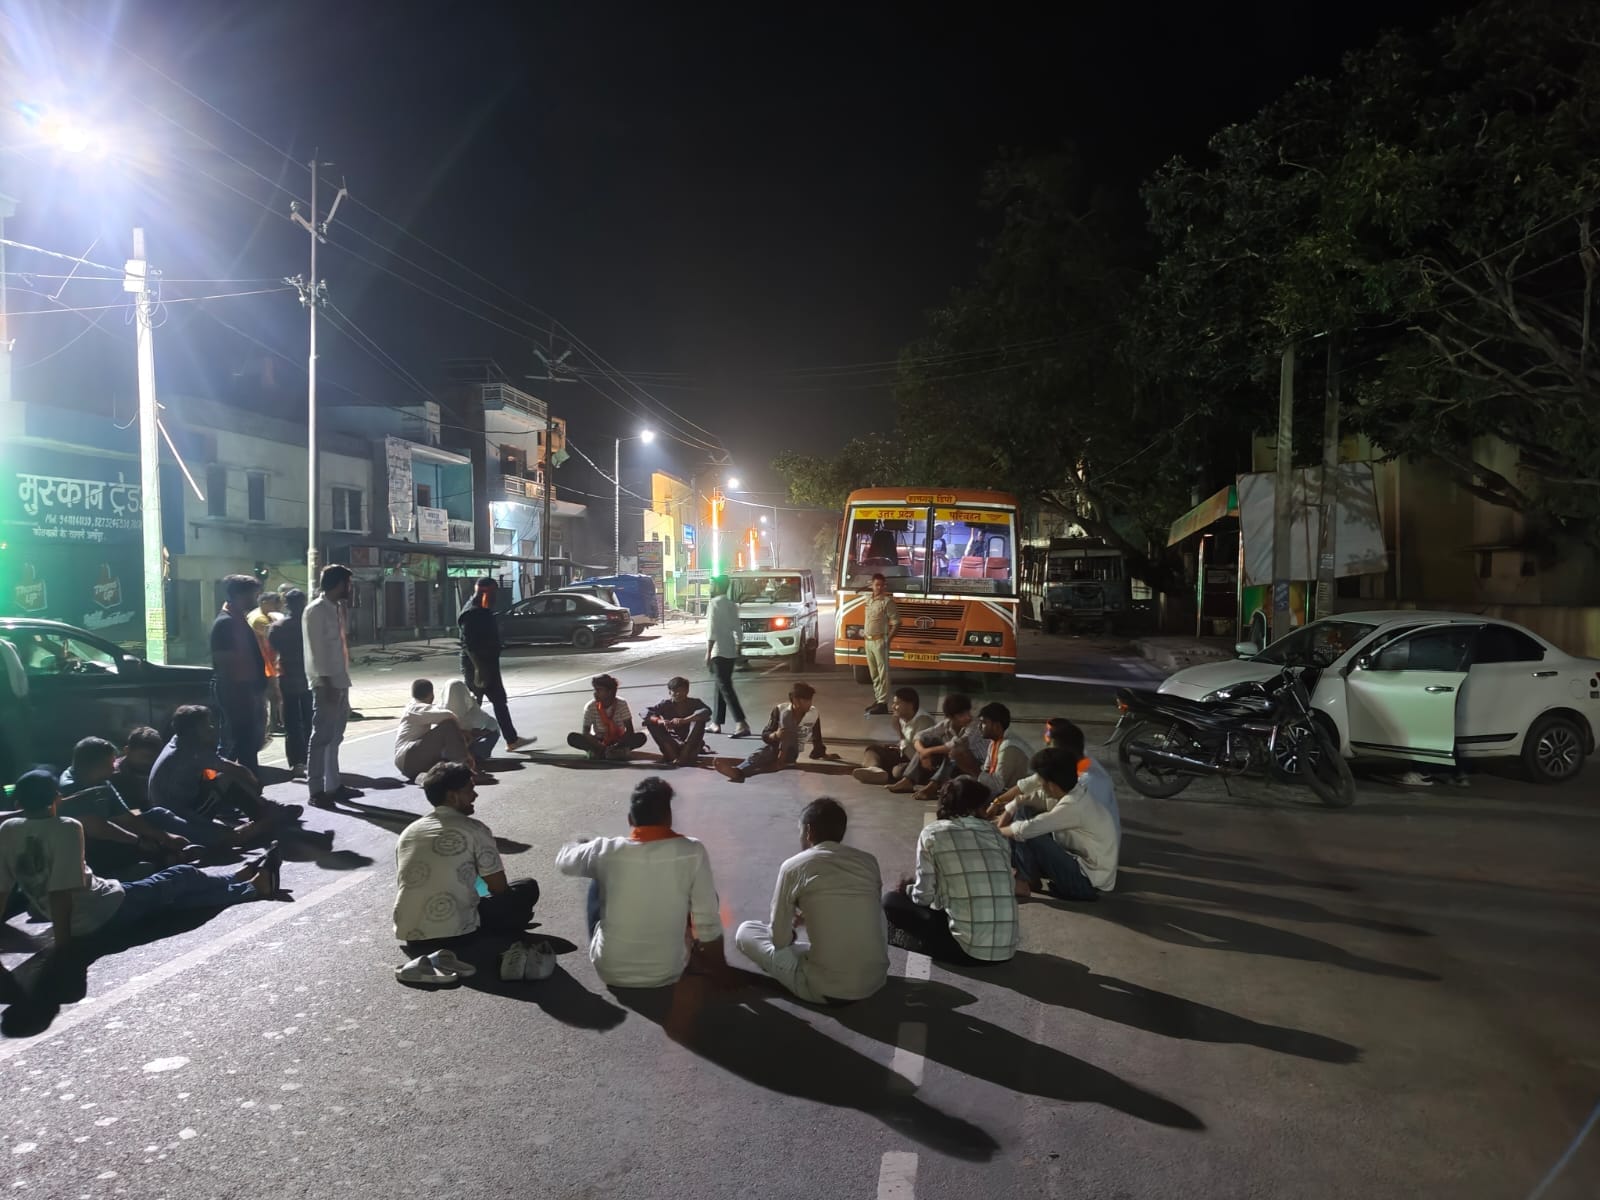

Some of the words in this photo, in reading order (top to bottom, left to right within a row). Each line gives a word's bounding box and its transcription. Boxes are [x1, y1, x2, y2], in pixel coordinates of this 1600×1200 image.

[16, 472, 106, 515] मुस्कान
[107, 471, 144, 516] ट्रेड
[949, 511, 981, 521] परिवहन
